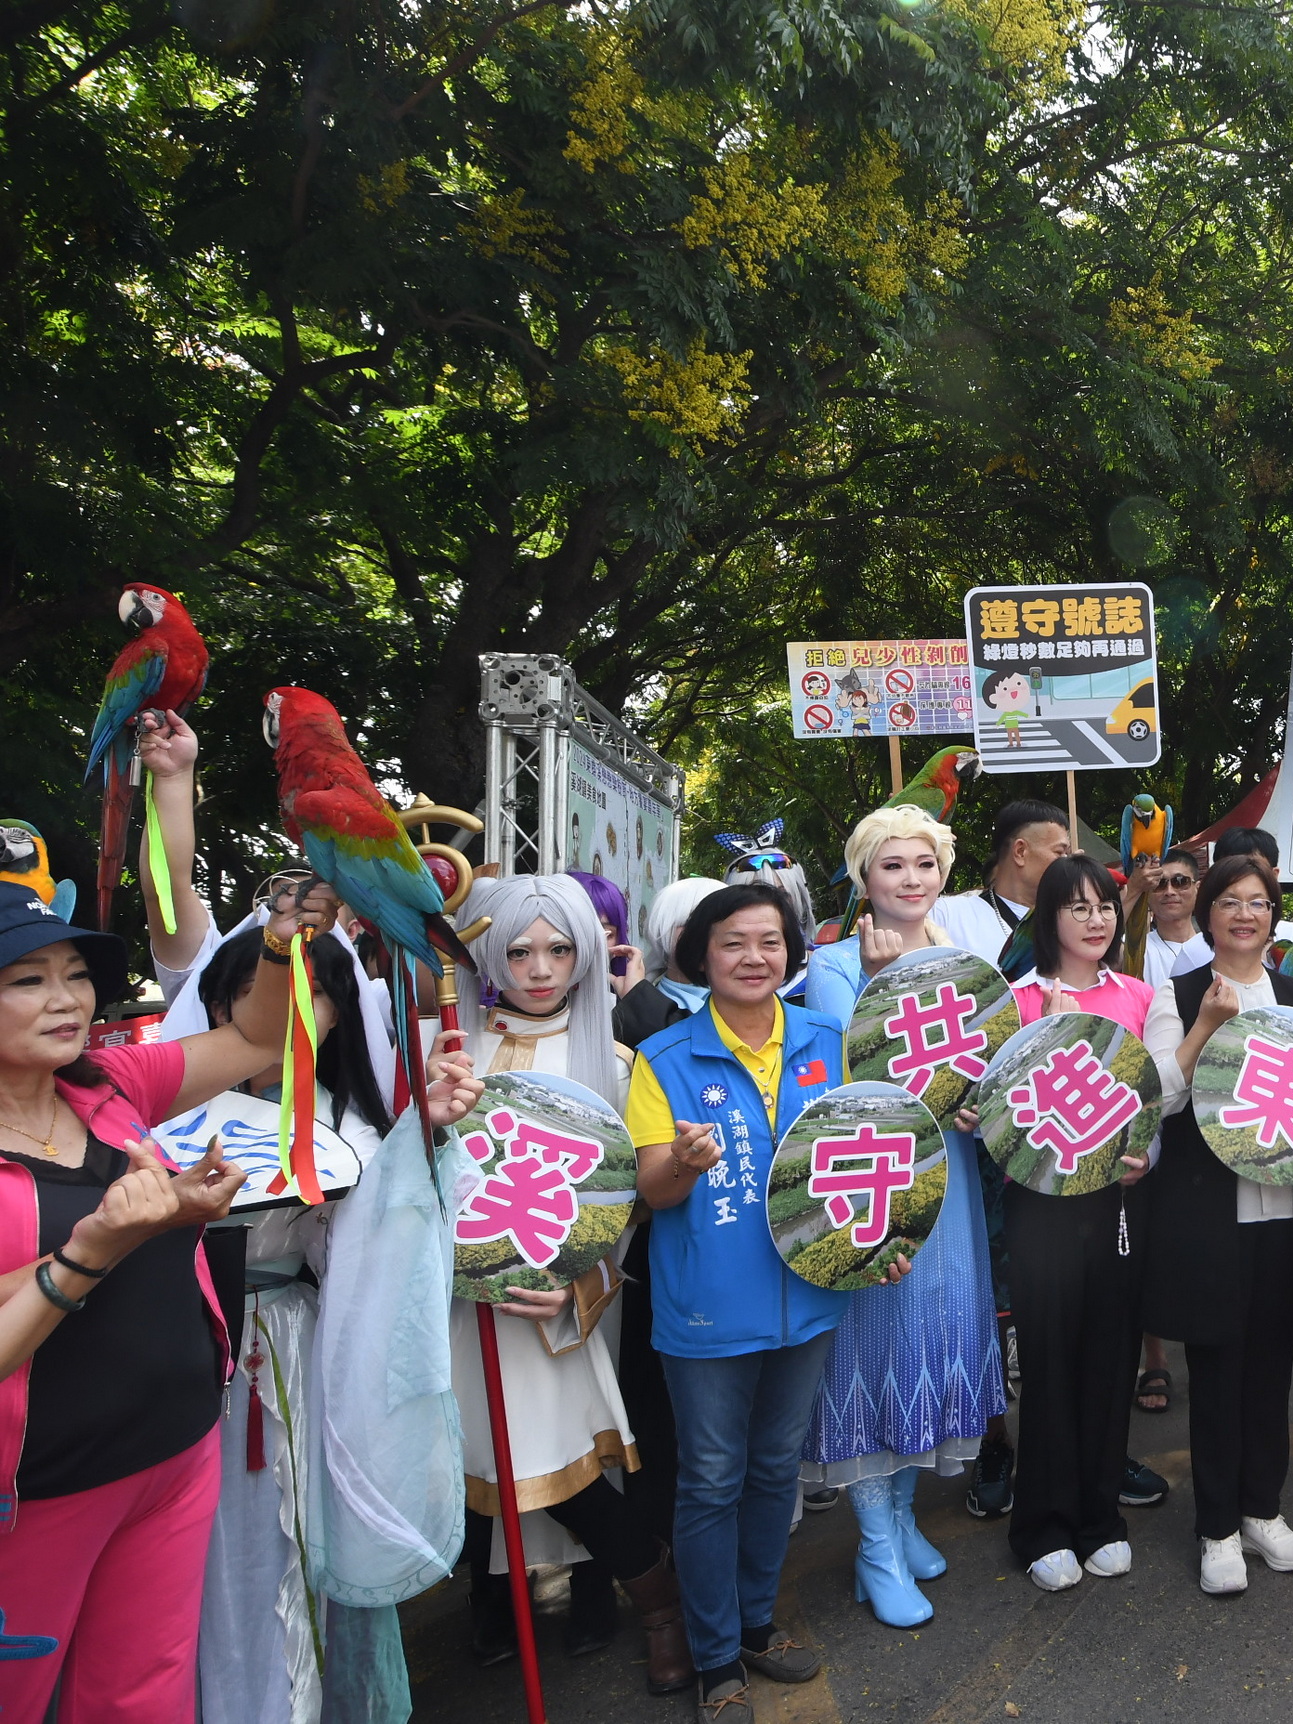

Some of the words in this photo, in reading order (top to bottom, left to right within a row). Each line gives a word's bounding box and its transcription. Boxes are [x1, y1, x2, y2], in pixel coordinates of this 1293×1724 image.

[980, 596, 1144, 640] 遵守號誌
[982, 639, 1145, 661] 綠燈秒數足夠再通過
[953, 675, 971, 690] 16
[957, 699, 972, 711] 11
[885, 982, 988, 1097] 共
[1008, 1041, 1141, 1173] 進
[727, 1109, 760, 1205] 溪湖鎮民代表
[809, 1124, 915, 1246] 守
